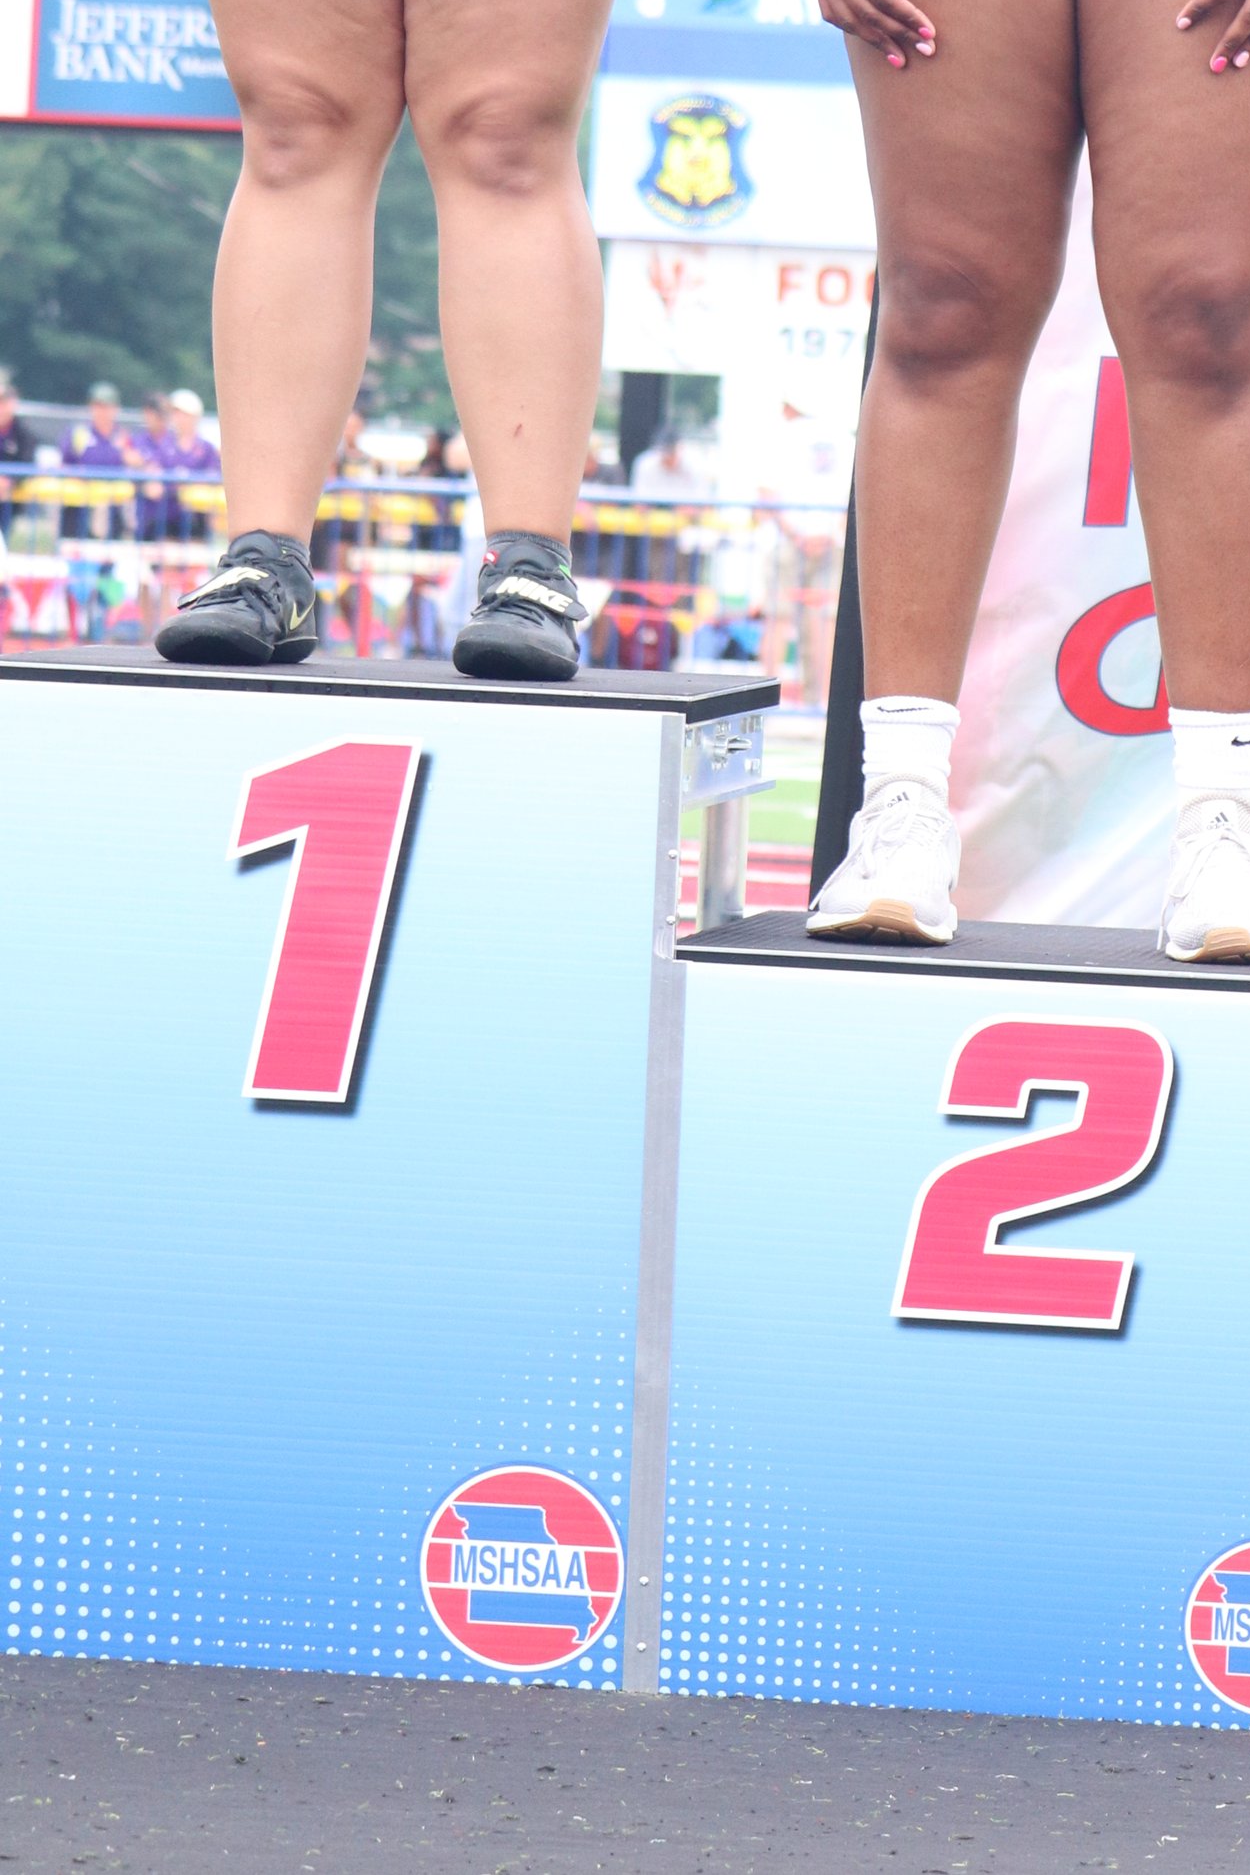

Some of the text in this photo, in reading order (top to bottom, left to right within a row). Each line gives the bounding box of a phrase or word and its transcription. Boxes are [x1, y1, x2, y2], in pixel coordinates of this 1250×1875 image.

[54, 45, 184, 92] BANK
[496, 576, 574, 613] NIKE
[225, 735, 425, 1104] 1
[890, 1011, 1175, 1331] 2
[453, 1541, 588, 1592] MSHSAA
